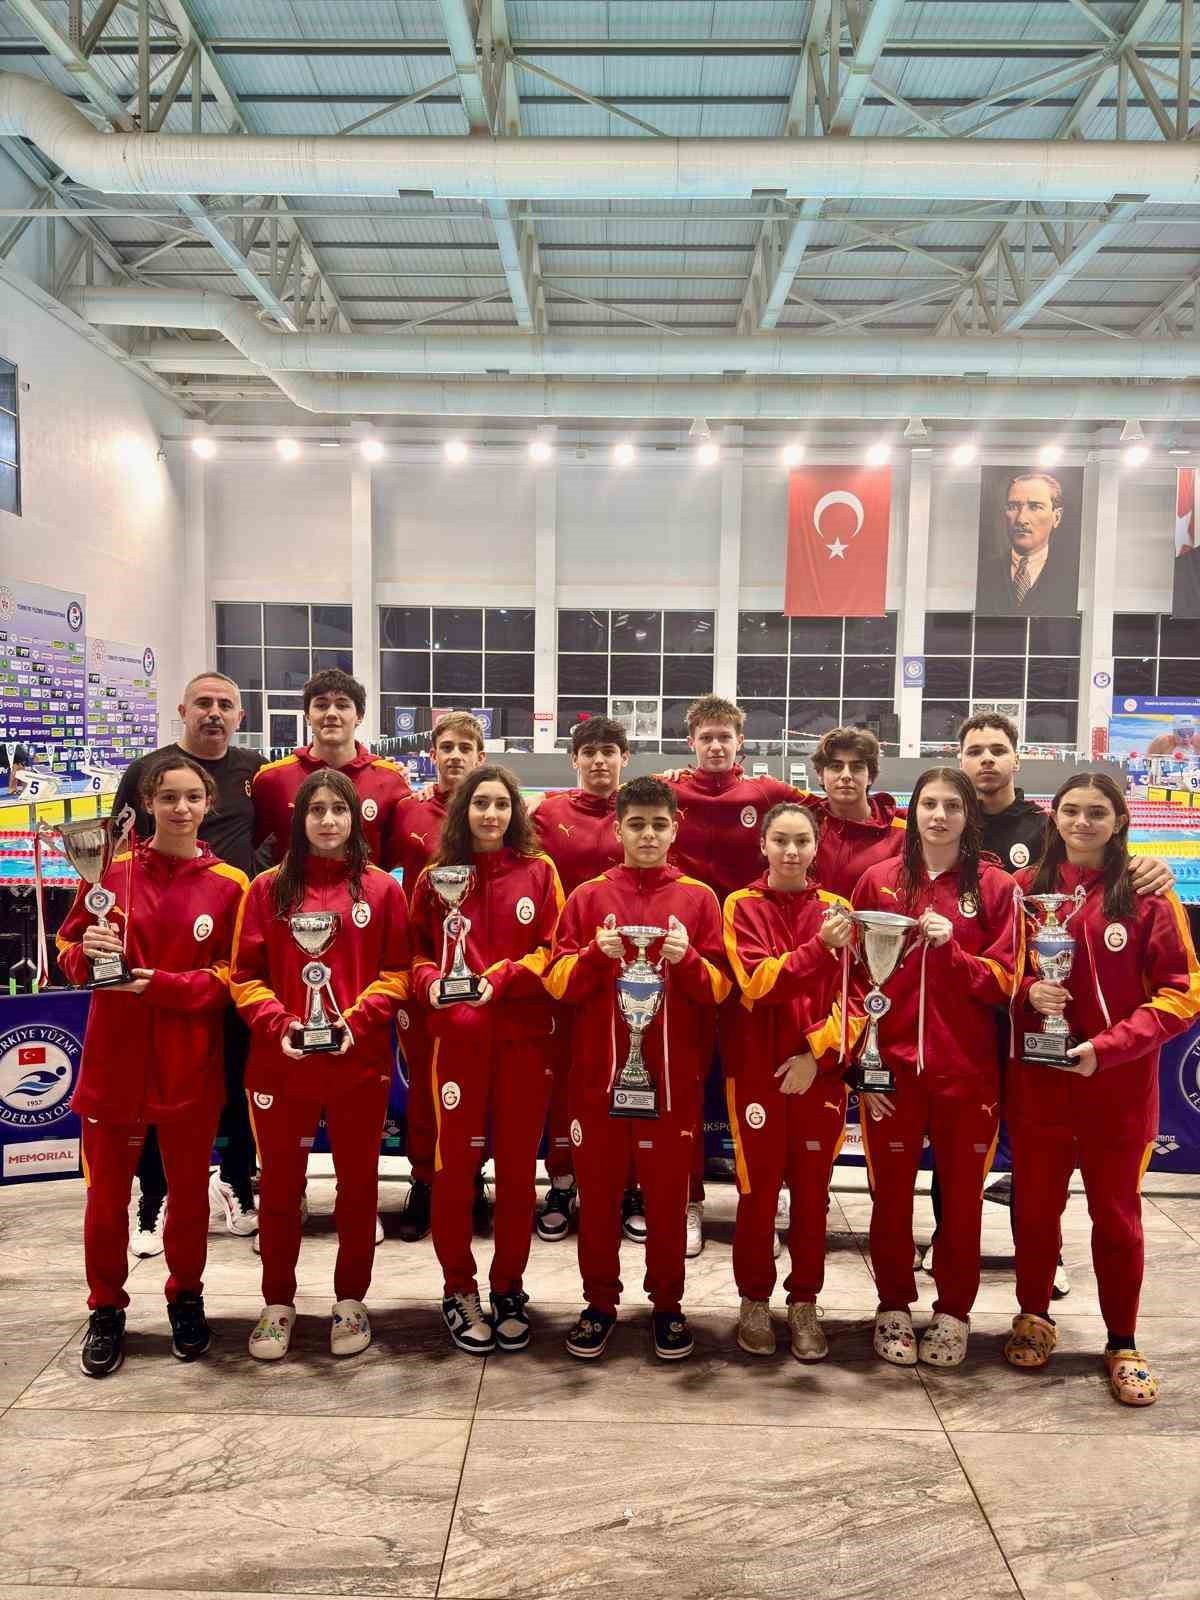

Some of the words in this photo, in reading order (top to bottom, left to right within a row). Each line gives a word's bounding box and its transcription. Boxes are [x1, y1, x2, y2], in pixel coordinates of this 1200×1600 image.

[30, 781, 39, 795] 5
[93, 776, 100, 790] 6
[1191, 777, 1198, 788] 9
[0, 1029, 36, 1056] RKİYE
[40, 1029, 79, 1055] YÜZME
[0, 1096, 72, 1123] DERASYON
[8, 1150, 74, 1164] MEMORIAL
